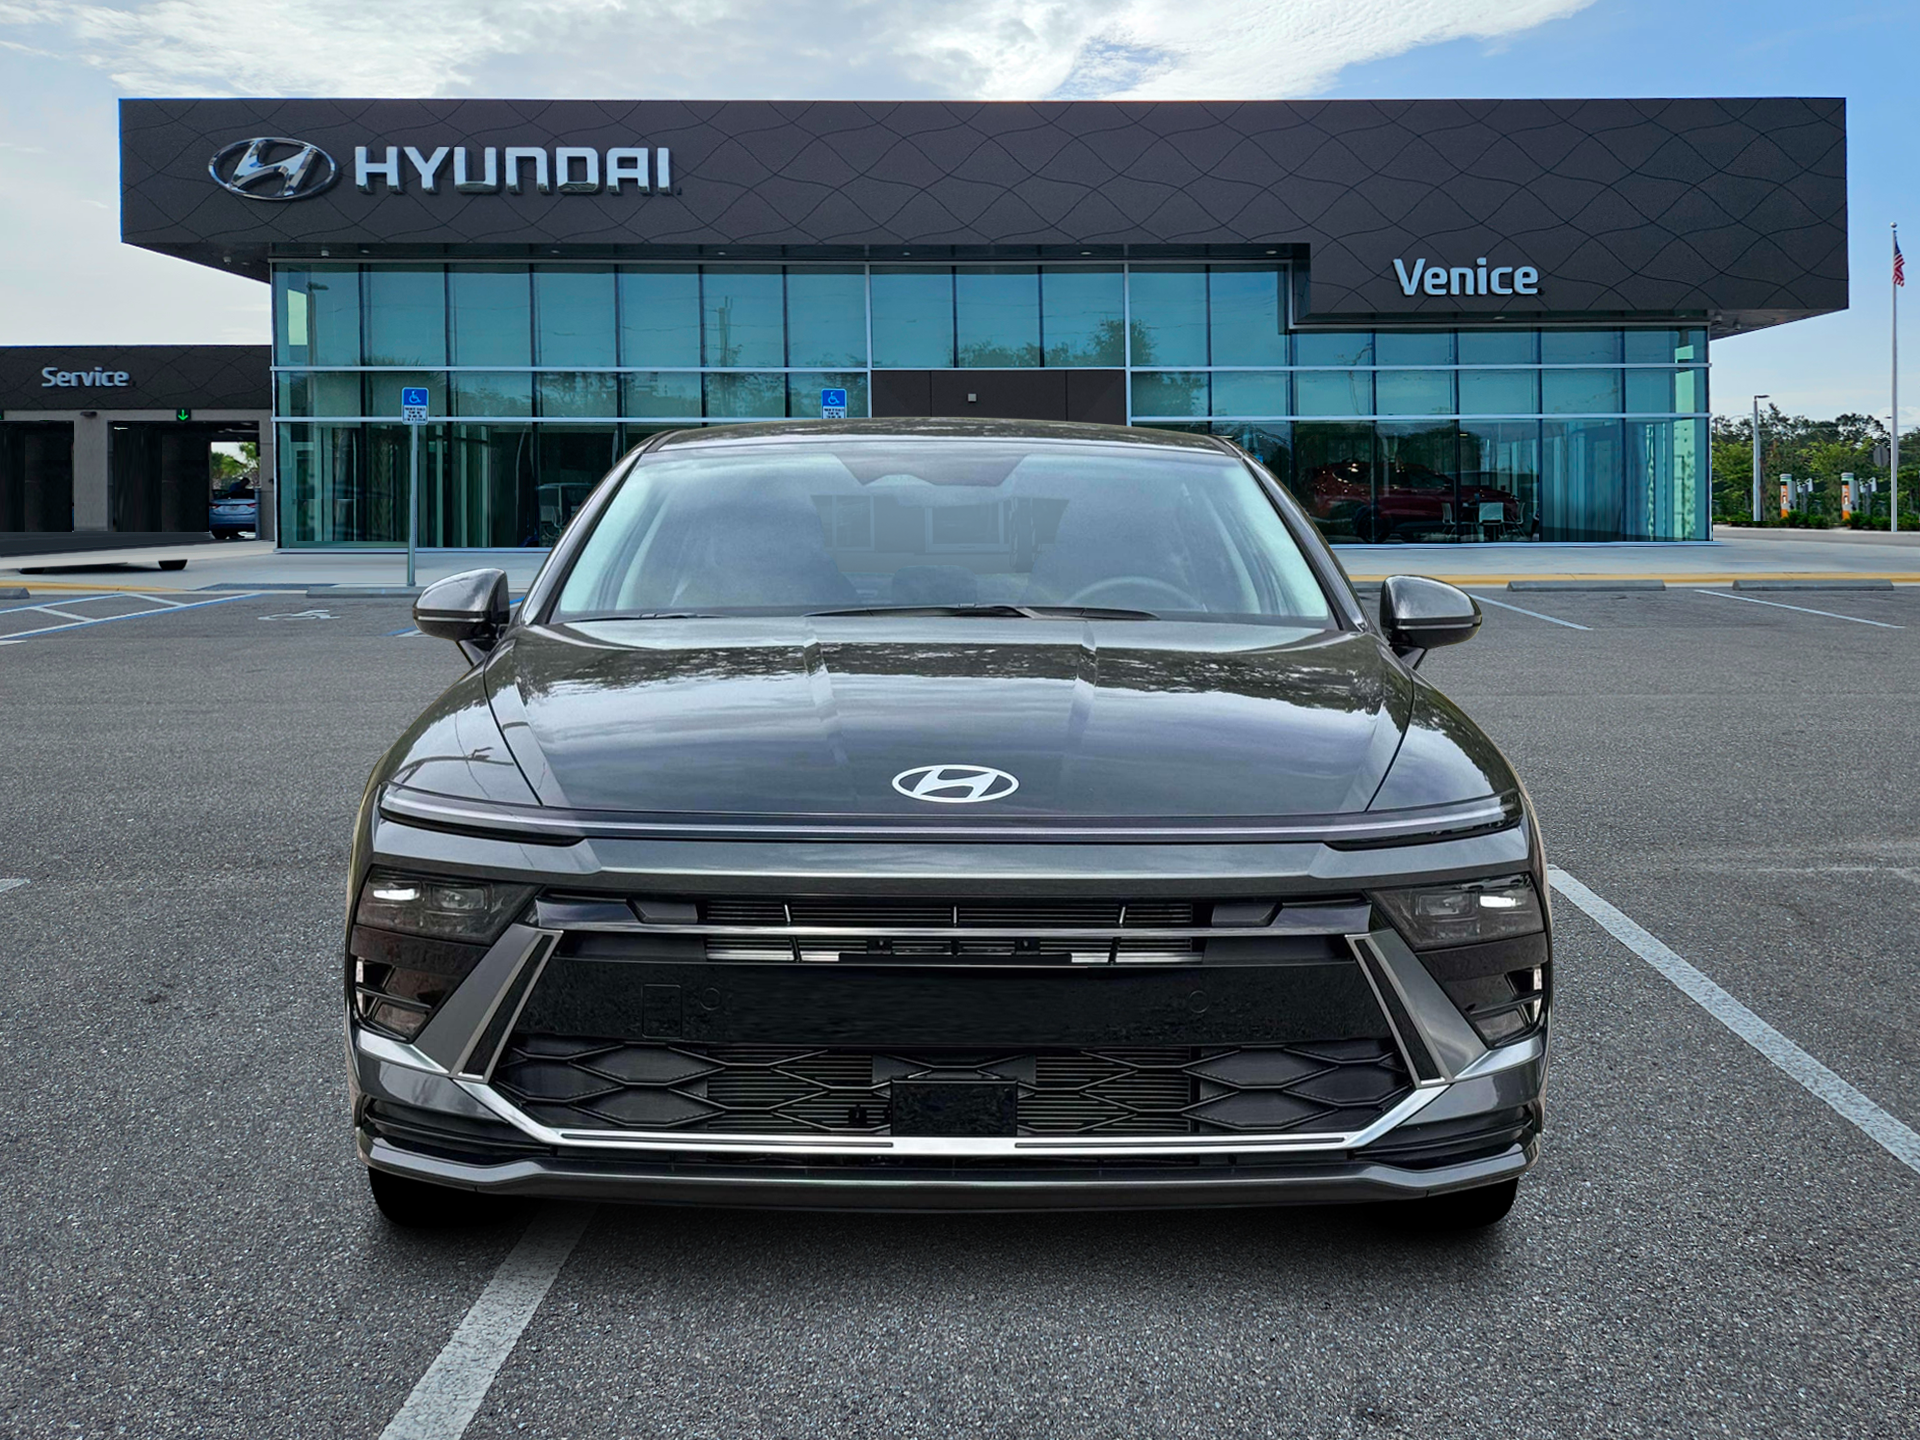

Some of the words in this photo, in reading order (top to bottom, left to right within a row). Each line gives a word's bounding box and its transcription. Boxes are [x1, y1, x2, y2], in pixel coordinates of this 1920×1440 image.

[354, 146, 670, 194] HYUNDAI
[1392, 257, 1539, 296] Venice
[41, 366, 130, 387] Service
